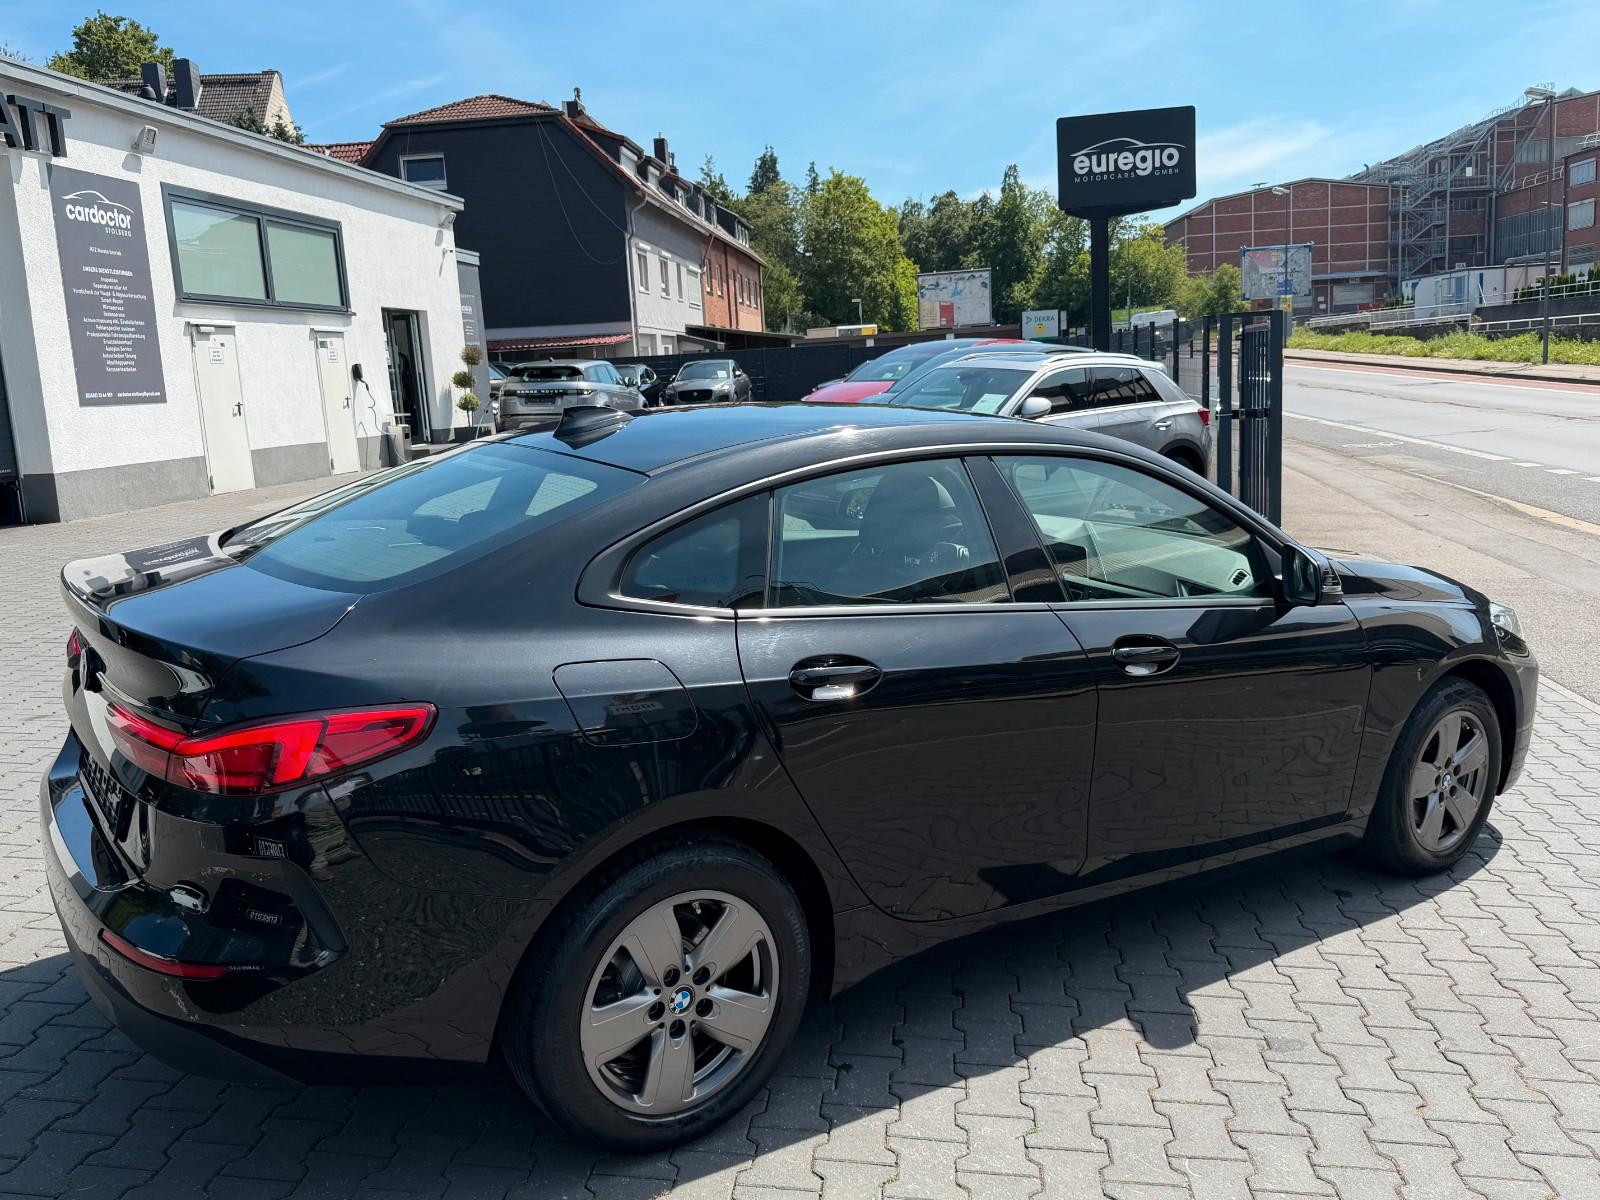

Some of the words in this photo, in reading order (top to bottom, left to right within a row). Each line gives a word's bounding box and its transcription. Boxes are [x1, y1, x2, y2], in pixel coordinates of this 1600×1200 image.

[1073, 147, 1180, 176] euregio
[1074, 172, 1136, 183] MOTORCARS
[65, 203, 132, 229] cardoctor
[105, 226, 132, 237] STOLBERG
[1034, 314, 1055, 324] DEKRA
